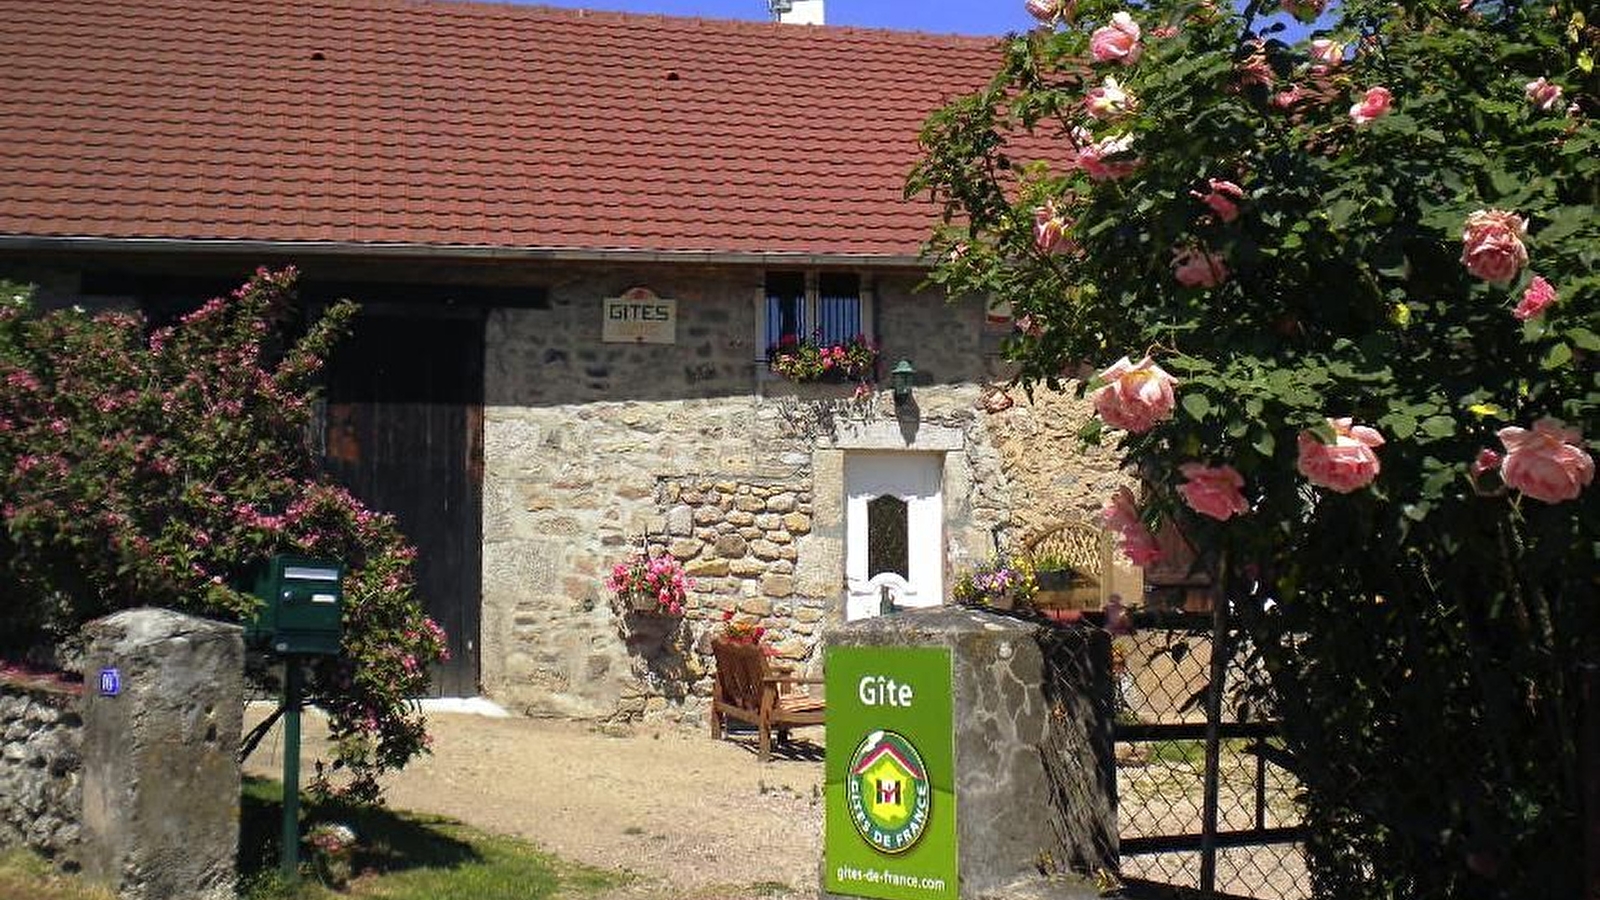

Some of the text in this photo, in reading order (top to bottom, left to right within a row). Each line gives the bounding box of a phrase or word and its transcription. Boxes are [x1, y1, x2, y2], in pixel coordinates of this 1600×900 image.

[609, 304, 669, 320] GITES
[859, 675, 913, 707] Gîte
[873, 830, 891, 847] DE
[896, 784, 927, 847] FRANCE
[837, 865, 945, 892] gites-de-france.com
